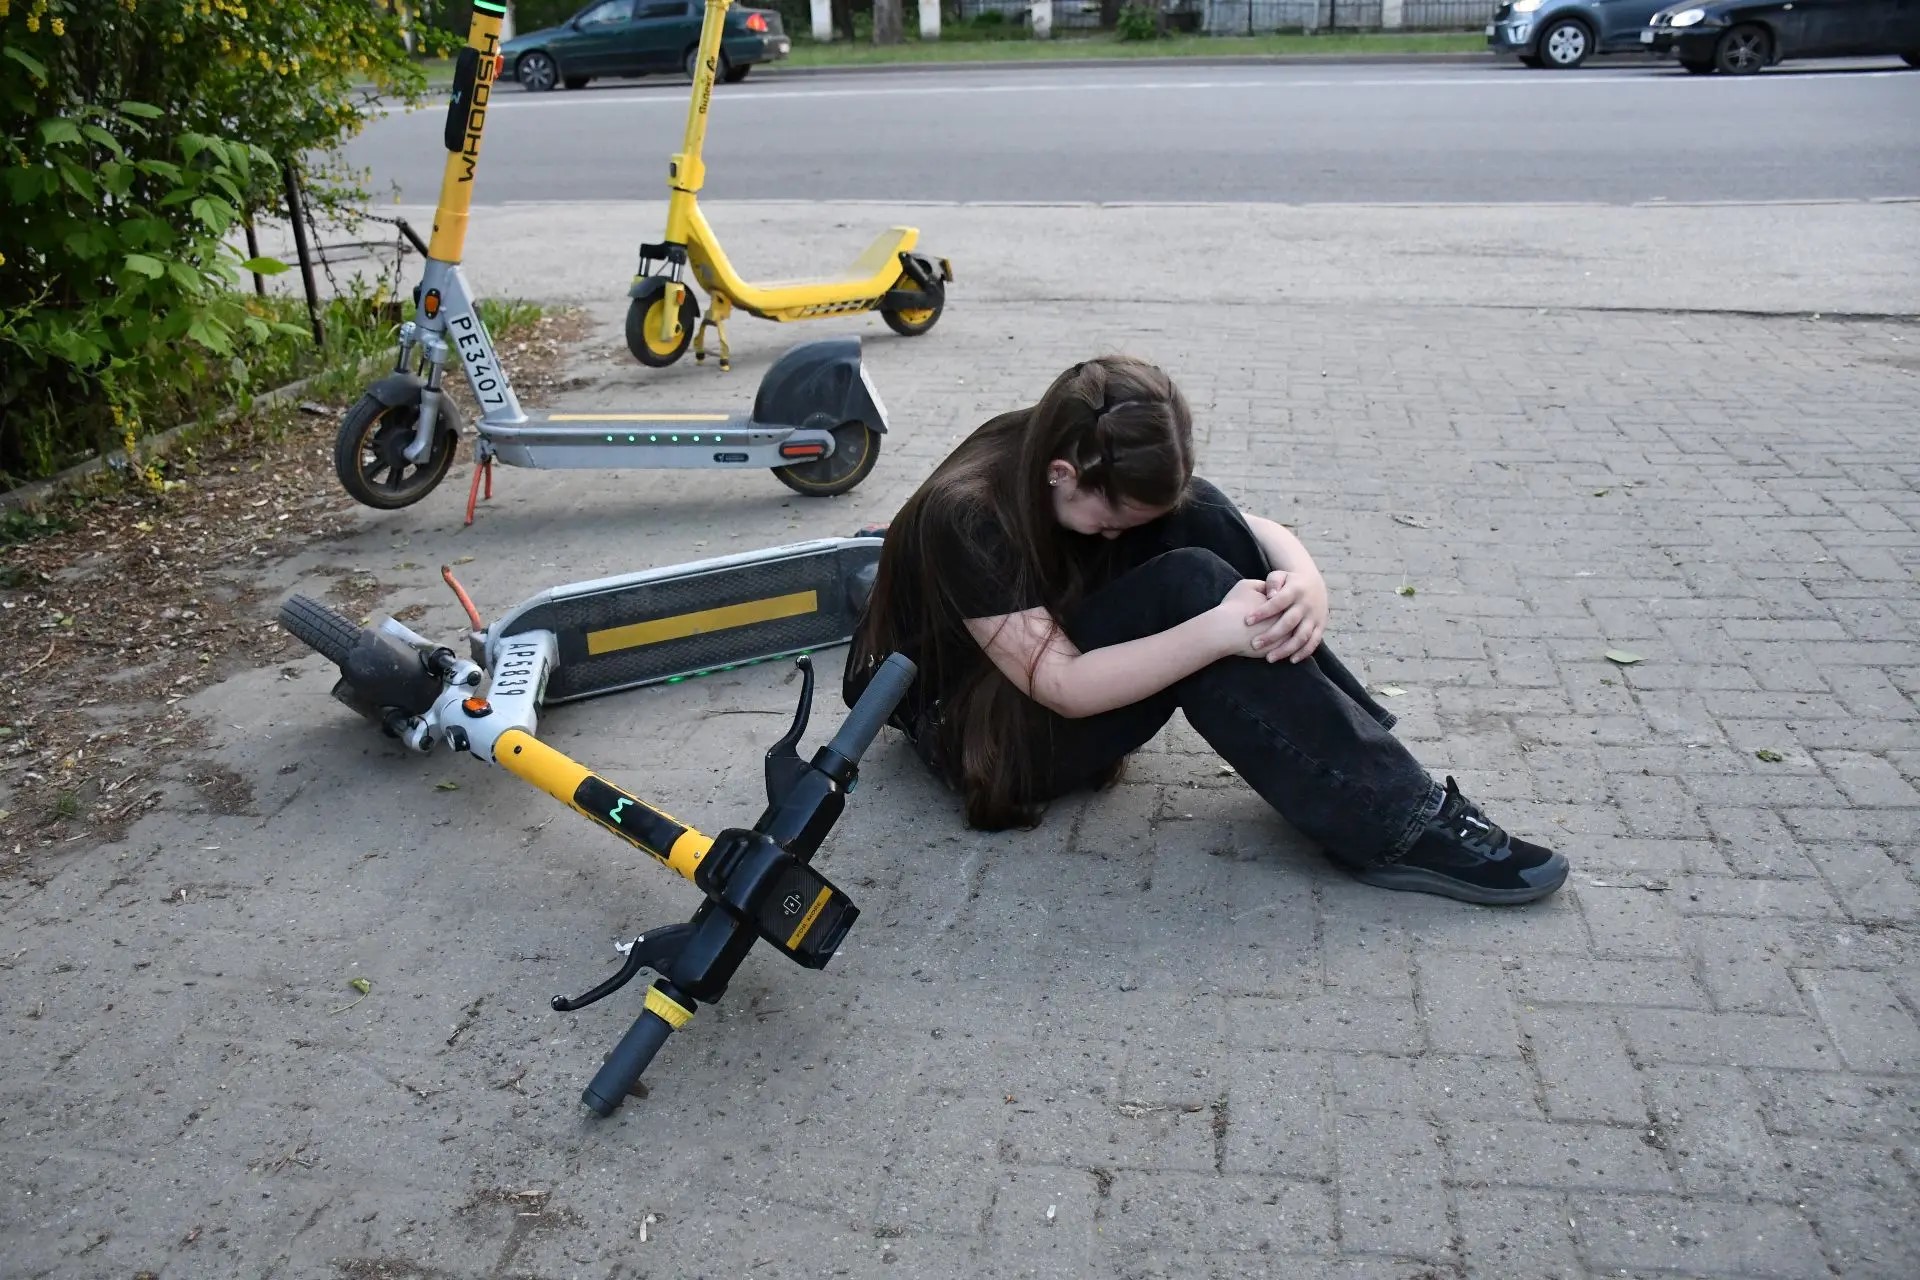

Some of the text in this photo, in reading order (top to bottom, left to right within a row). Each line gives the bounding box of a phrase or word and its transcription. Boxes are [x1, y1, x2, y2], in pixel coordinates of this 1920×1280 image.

[457, 33, 499, 182] WHOOSH
[451, 315, 504, 406] PE3407
[495, 643, 539, 697] AP5839
[807, 902, 821, 922] MORE
